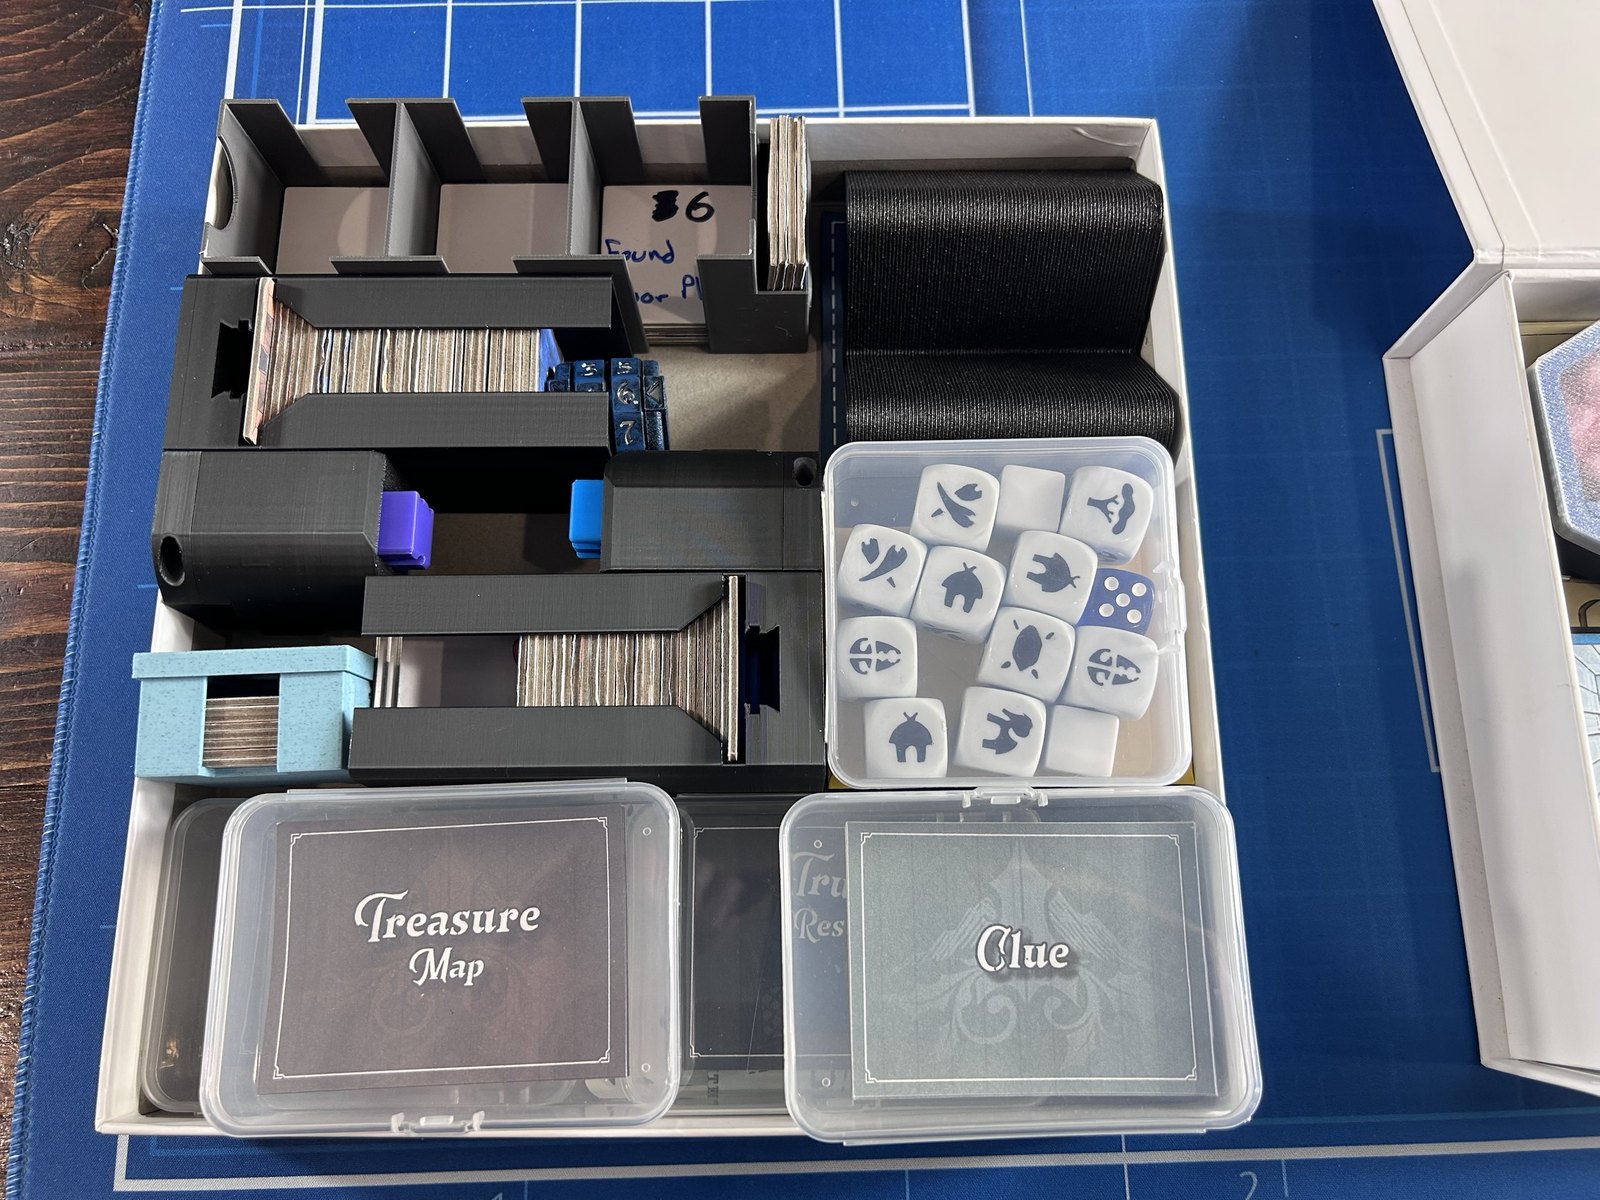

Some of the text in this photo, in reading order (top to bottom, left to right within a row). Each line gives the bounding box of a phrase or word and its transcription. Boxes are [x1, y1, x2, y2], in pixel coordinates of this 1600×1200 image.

[605, 238, 675, 264] Found
[619, 420, 635, 445] 7
[791, 850, 848, 899] Tru
[354, 889, 541, 942] Treasure
[794, 907, 846, 944] Res
[408, 946, 485, 987] Map
[977, 924, 1070, 972] Clue
